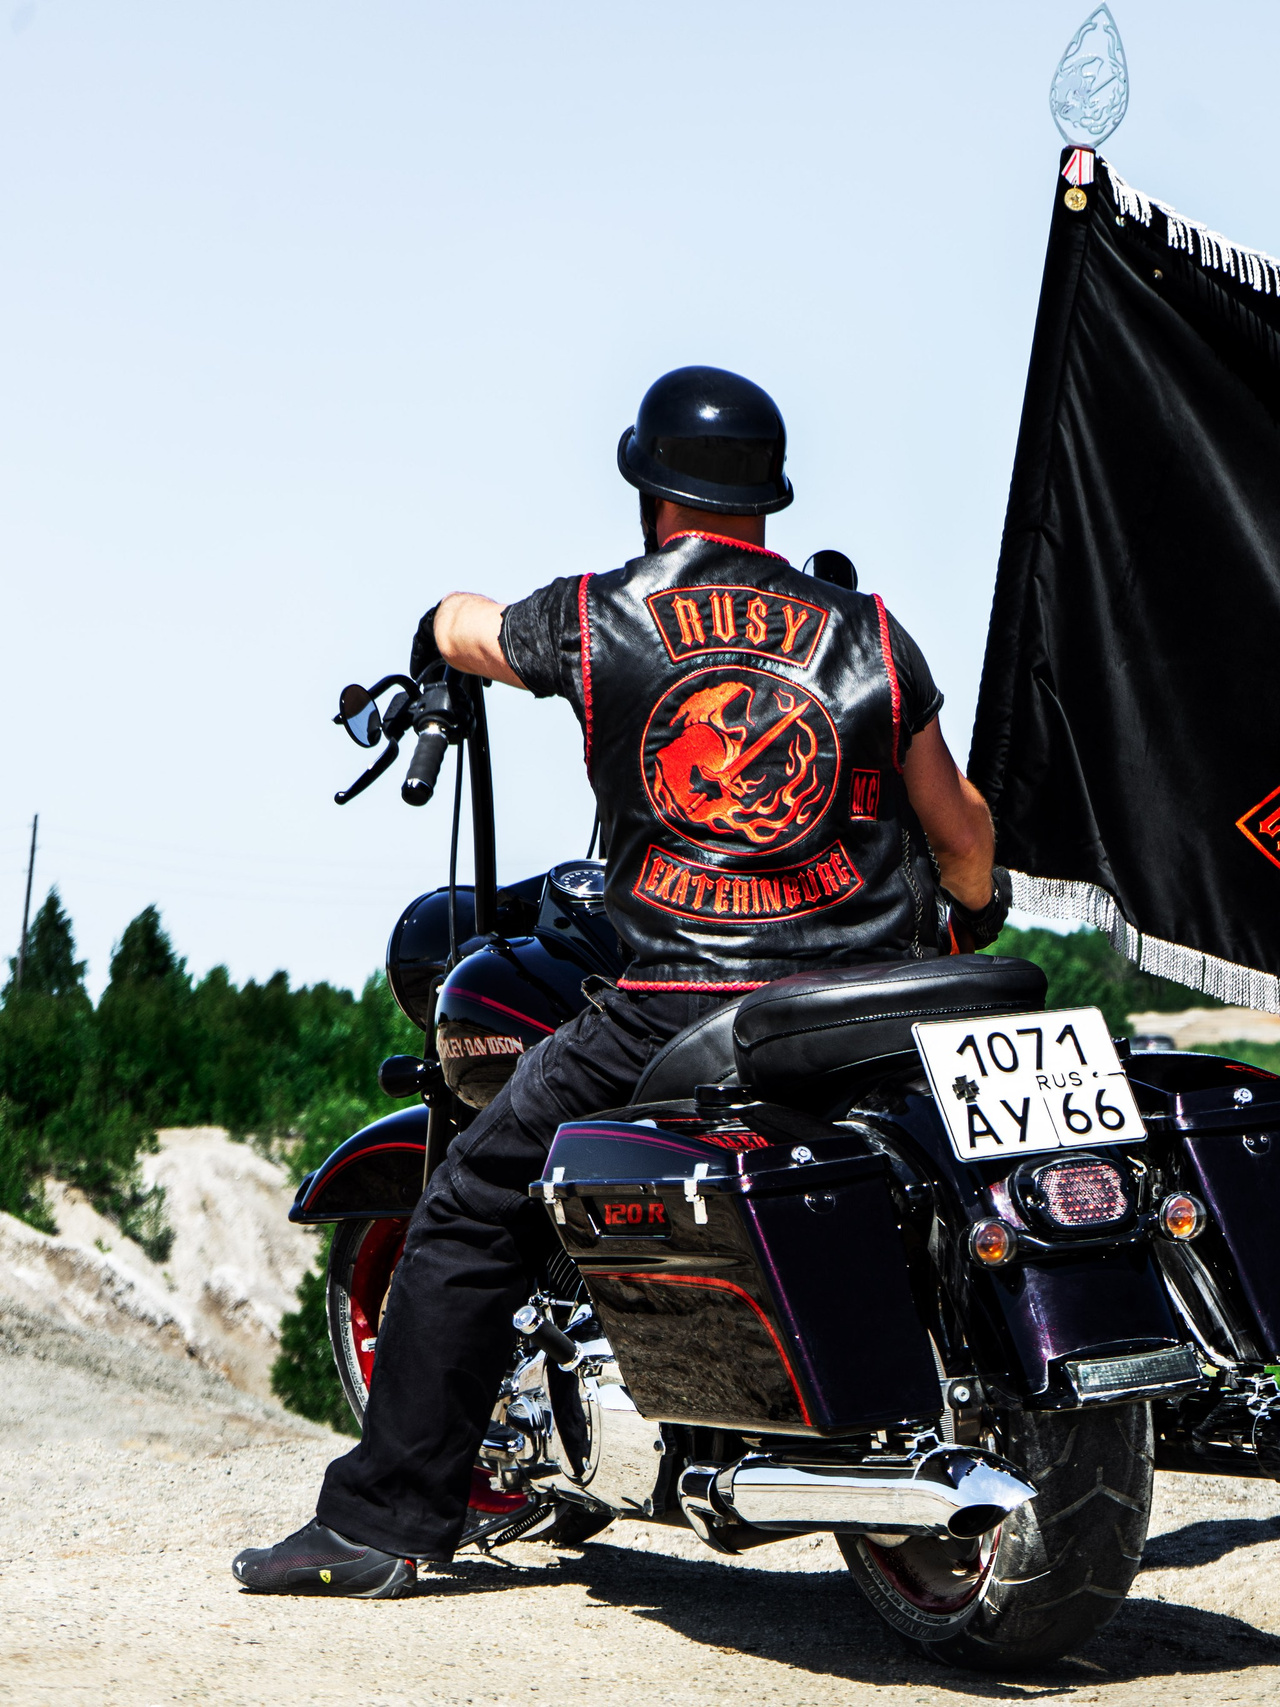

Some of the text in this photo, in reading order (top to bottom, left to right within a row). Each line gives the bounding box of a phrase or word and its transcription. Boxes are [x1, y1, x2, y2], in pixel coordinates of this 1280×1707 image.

[672, 590, 810, 654] RUSY
[853, 775, 877, 813] MC
[645, 852, 851, 915] EKATERINBURG
[956, 1024, 1088, 1077] 1071
[1036, 1072, 1083, 1090] RUS
[966, 1089, 1126, 1149] AY 66
[604, 1203, 666, 1225] 120 R
